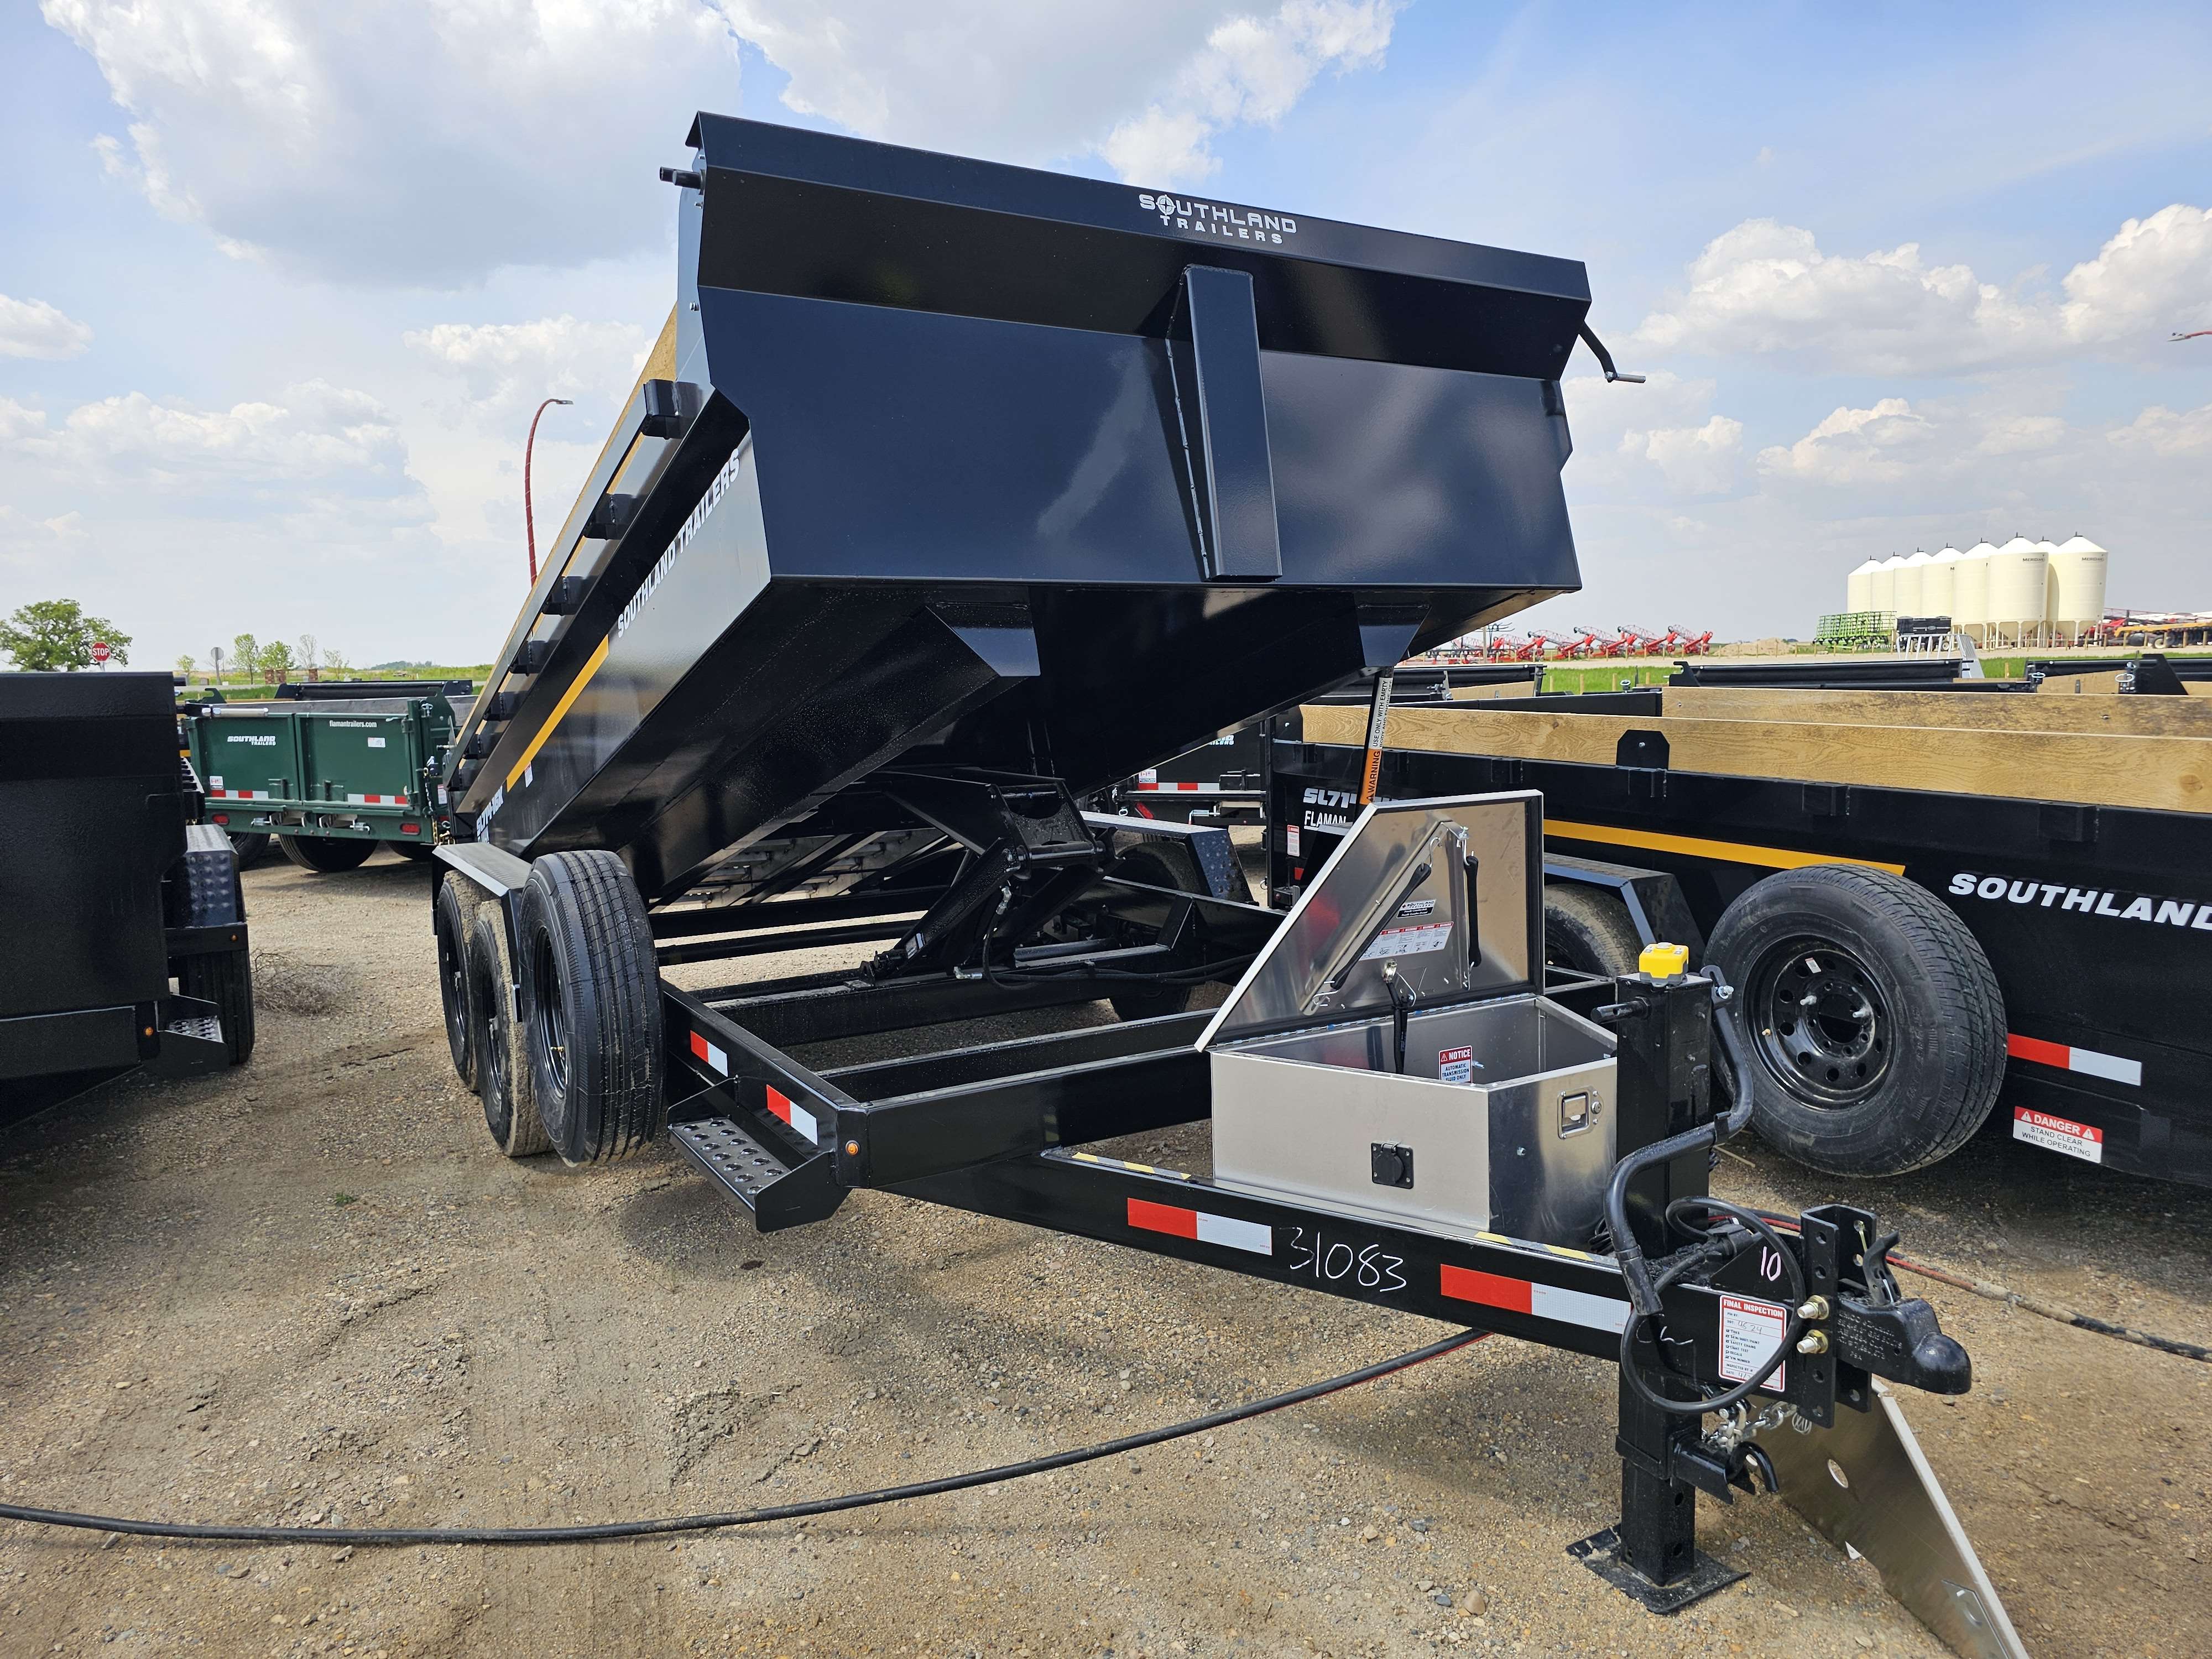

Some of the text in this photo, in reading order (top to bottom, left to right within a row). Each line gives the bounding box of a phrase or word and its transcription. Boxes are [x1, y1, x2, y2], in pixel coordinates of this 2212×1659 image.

[1139, 194, 1297, 233] SOUTHLAND
[1160, 215, 1282, 244] TRAILERS
[618, 448, 740, 638] SOUTHLAND TRAILERS
[92, 648, 109, 656] STOP
[1368, 751, 1380, 794] WARNING
[1304, 810, 1347, 827] FLAMAN
[1449, 1049, 1470, 1060] NOTICE
[1442, 1069, 1469, 1077] TRANSMISSION
[2031, 1126, 2083, 1146] STAND CLEAR
[2034, 1114, 2080, 1135] DANGER
[2022, 1131, 2091, 1157] WHILE OPERATING
[1280, 1227, 1406, 1292] 31083
[1761, 1246, 1781, 1281] 10
[1723, 1298, 1783, 1318] FINAL INSPECTION
